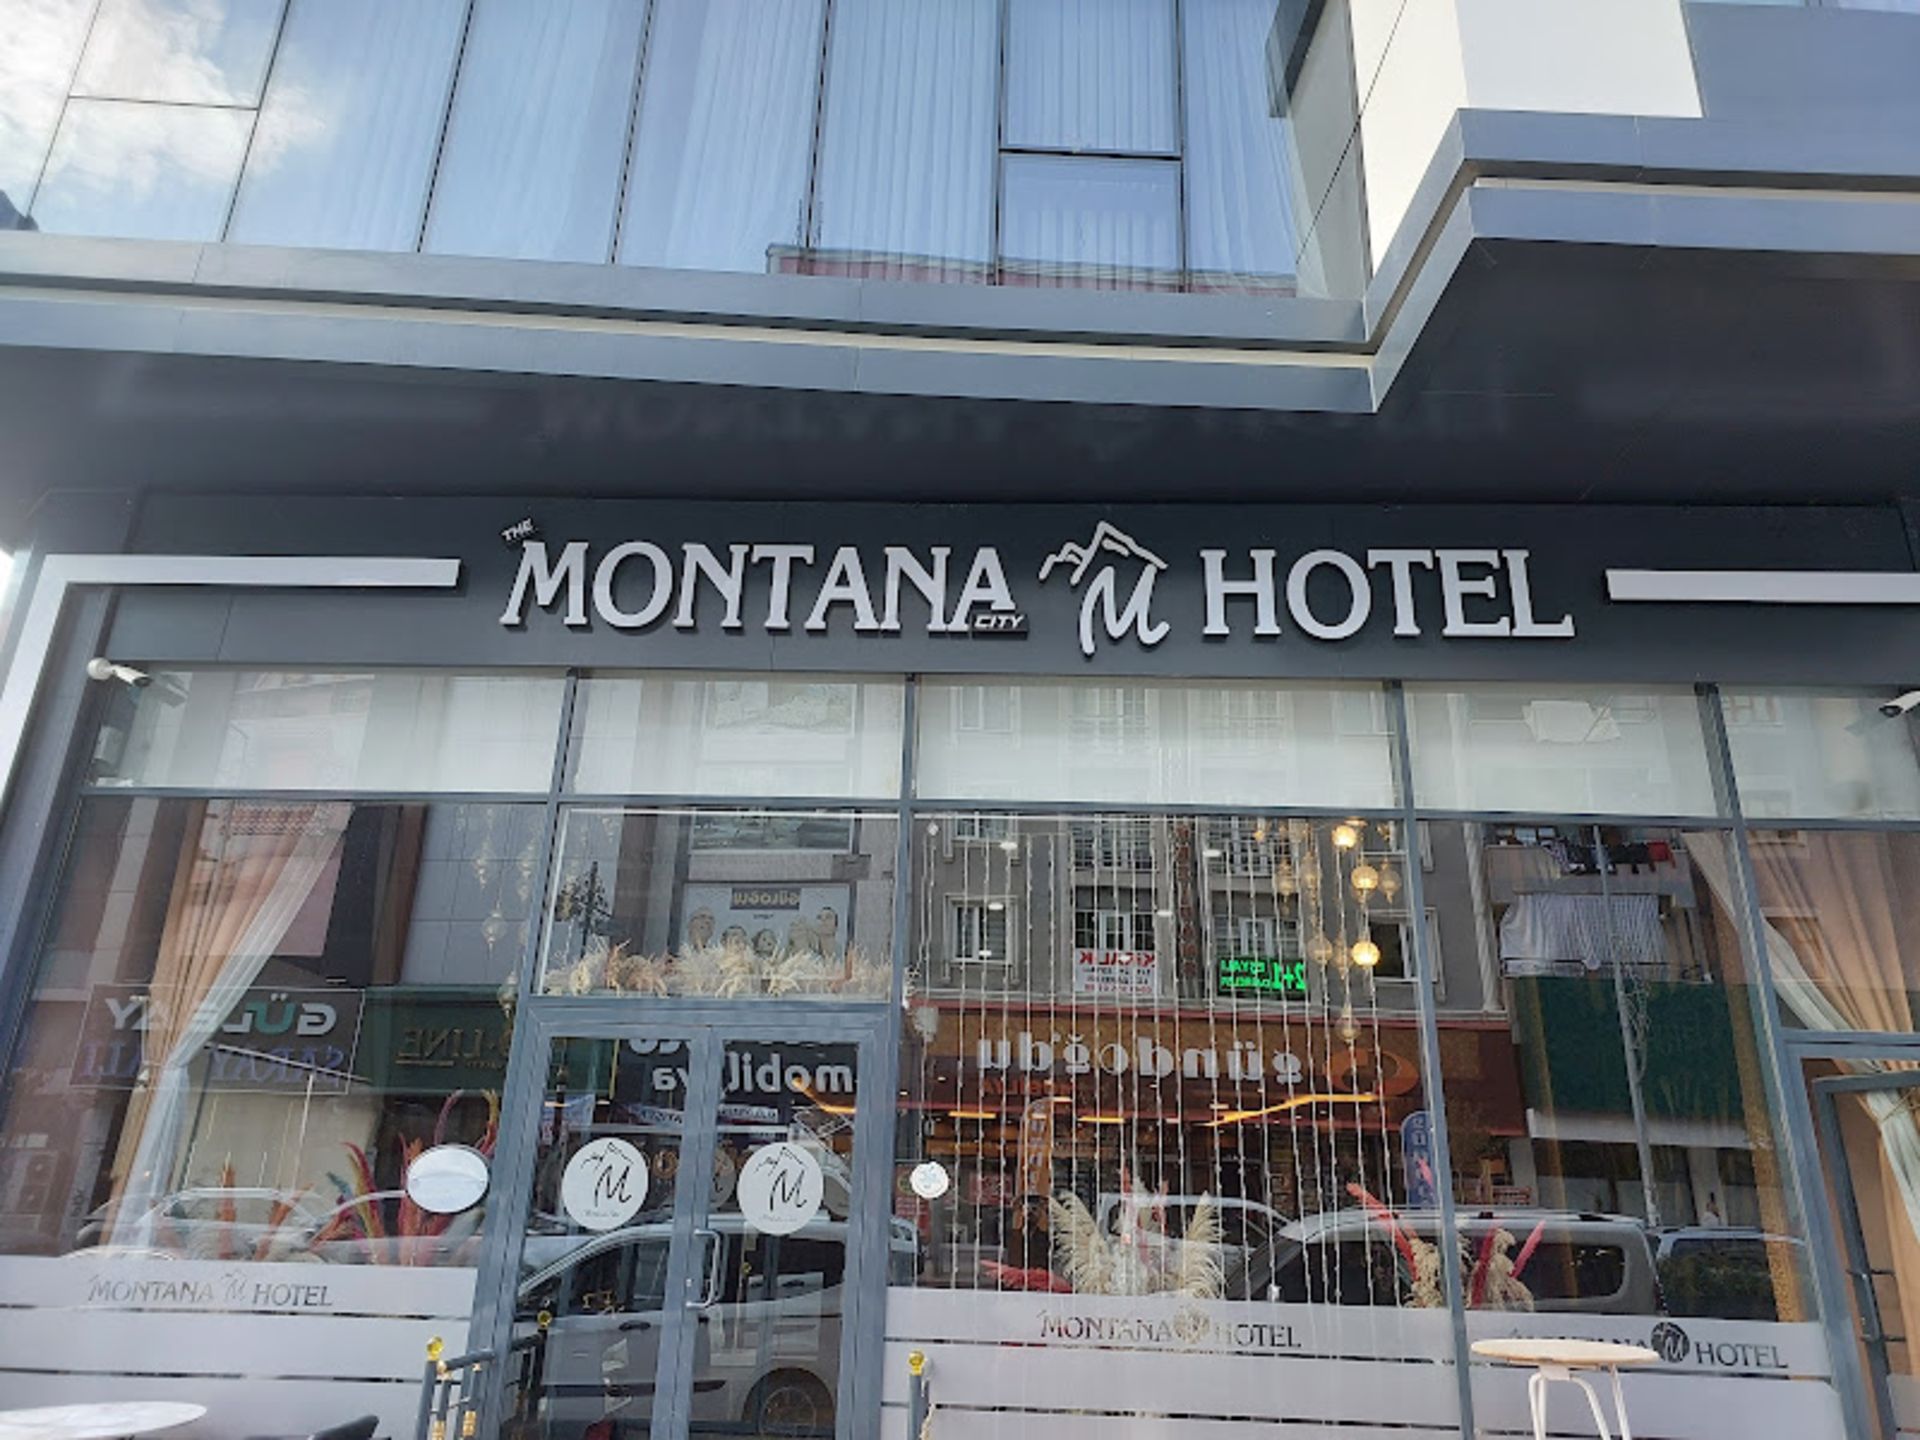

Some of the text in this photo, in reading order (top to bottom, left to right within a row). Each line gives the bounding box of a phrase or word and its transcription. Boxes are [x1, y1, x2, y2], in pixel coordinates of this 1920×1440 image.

[501, 517, 534, 541] THE
[500, 541, 1016, 632] MONTANA
[1200, 548, 1575, 640] HOTEL
[974, 613, 1025, 629] CITY
[88, 1280, 214, 1301] MONTANA
[252, 1283, 333, 1307] HOTEL
[1041, 1315, 1301, 1347] MONTANA HOTEL
[1697, 1341, 1789, 1369] HOTEL
